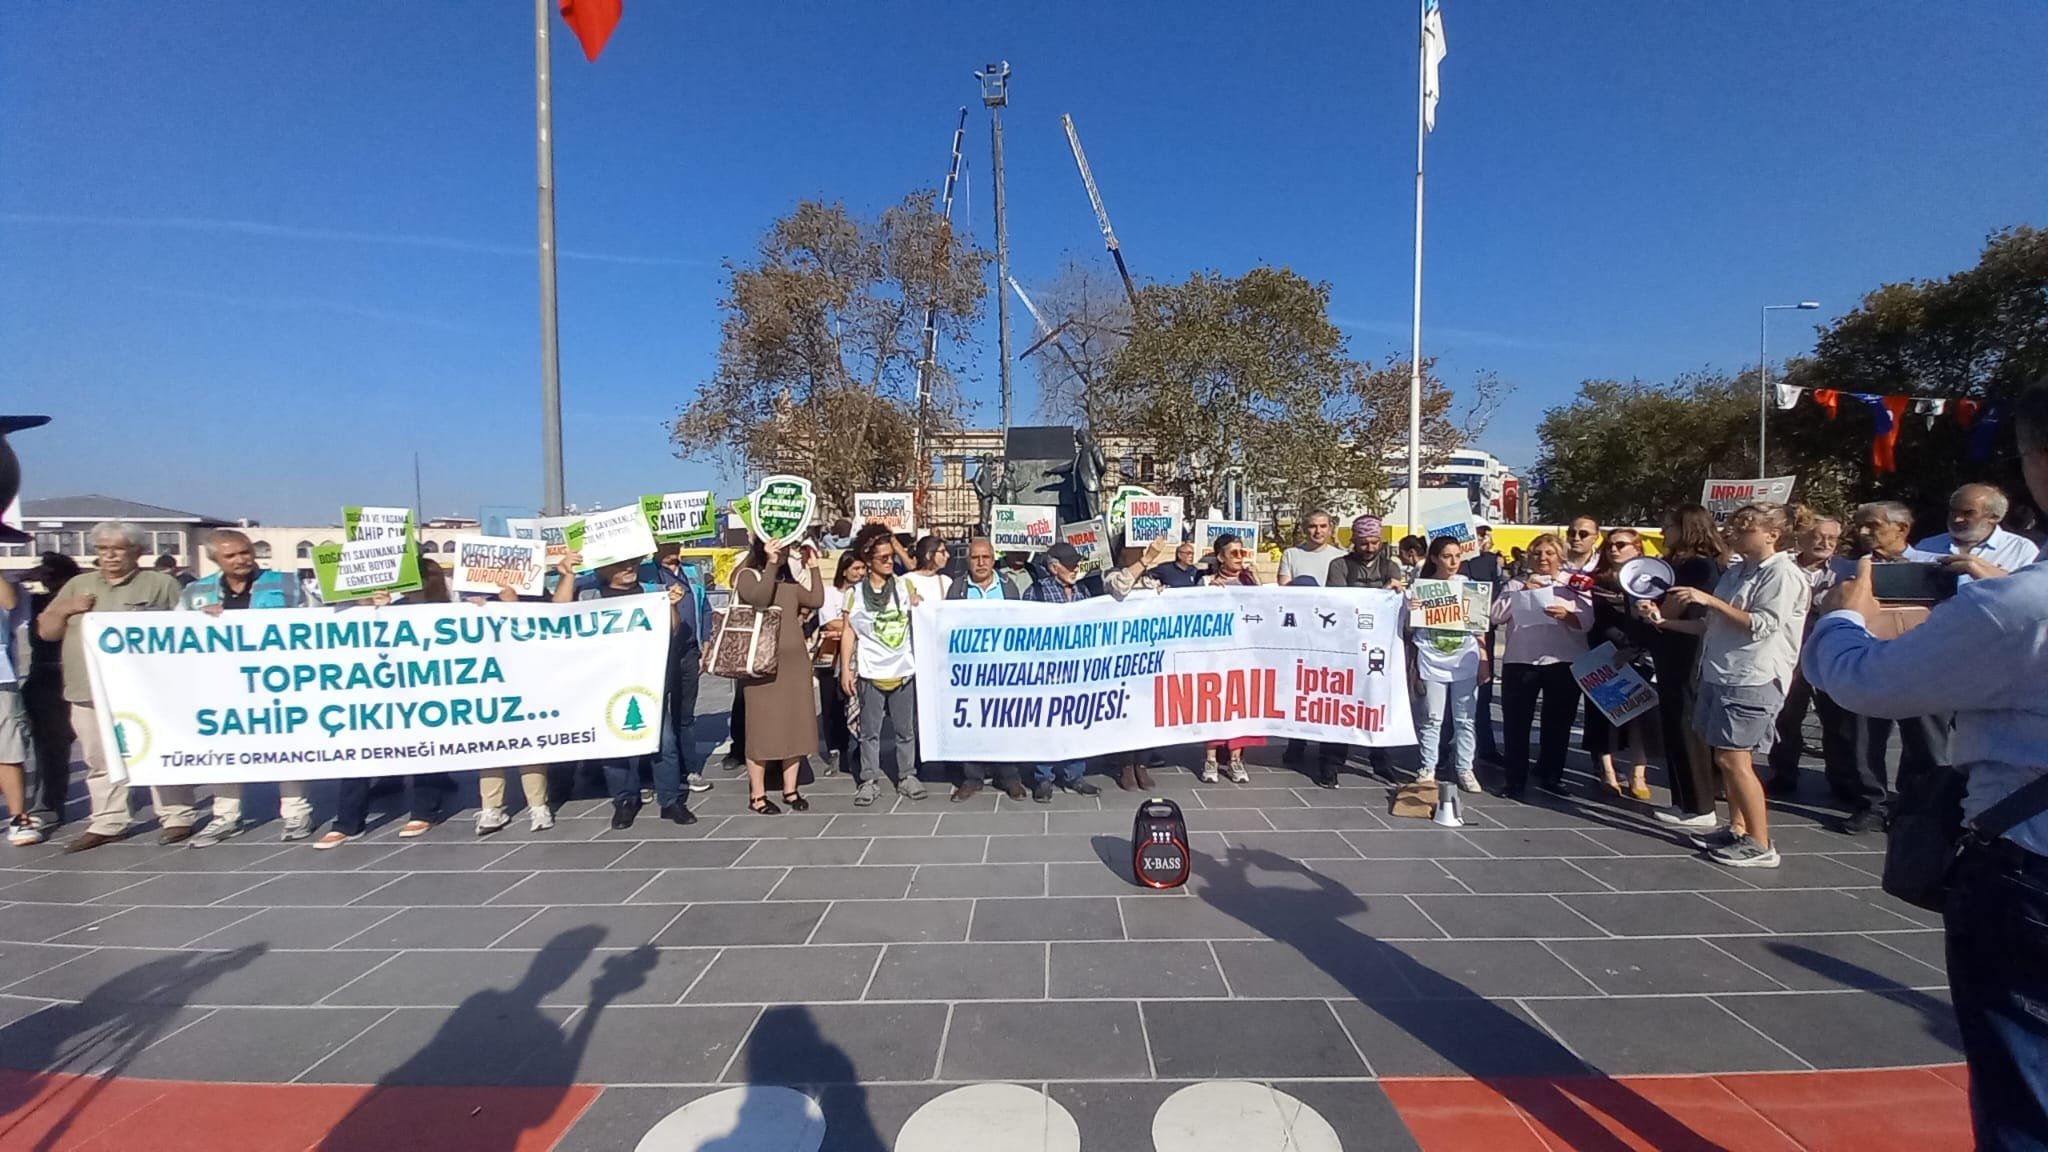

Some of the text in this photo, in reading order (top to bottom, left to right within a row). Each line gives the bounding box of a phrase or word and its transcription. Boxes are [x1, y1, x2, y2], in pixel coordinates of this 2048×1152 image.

[651, 509, 709, 532] SAHİP ÇIK
[674, 499, 684, 510] VE
[1131, 501, 1162, 517] INRAIL
[350, 525, 384, 542] SAHİP
[368, 558, 397, 572] BOYUN
[1416, 581, 1452, 599] MEGA
[949, 611, 1235, 654] KUZEY ORMANLARI'NI PARÇALAYACAK
[240, 653, 505, 694] TOPRAĞIMIZA
[950, 650, 1165, 687] SU HAVZALARINI YOK EDECEK
[1296, 658, 1354, 696] İptal
[952, 681, 1131, 731] 5. YIKIM PROJESİ:
[1154, 667, 1286, 728] INRAIL
[1295, 695, 1385, 733] Edilsin!
[196, 698, 309, 737] SAHİP
[318, 696, 560, 739] ÇIKIYORUZ...
[160, 727, 597, 768] TÜRKİYE ORMANCILAR DERNEĞİ MARMARA ŞUBESİ
[1143, 857, 1181, 870] X-BASS
